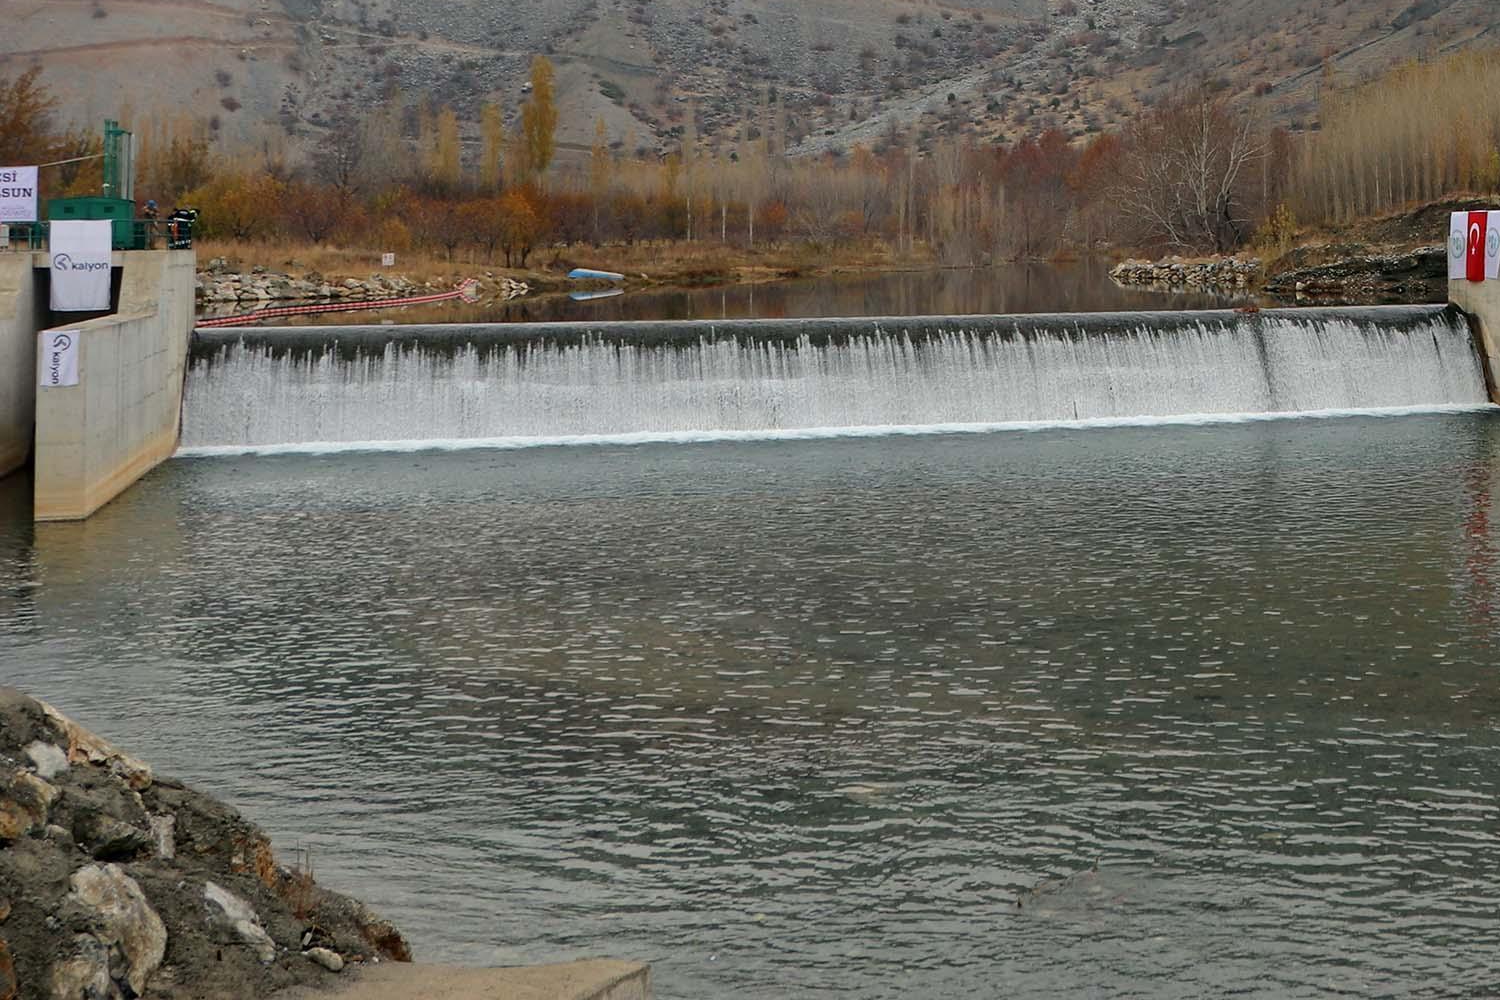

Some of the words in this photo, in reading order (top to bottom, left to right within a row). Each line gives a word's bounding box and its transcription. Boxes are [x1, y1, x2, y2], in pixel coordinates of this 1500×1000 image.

[0, 170, 17, 183] Sİ
[0, 187, 32, 198] SUN
[71, 261, 109, 272] kalyon
[50, 351, 61, 385] kalyon
